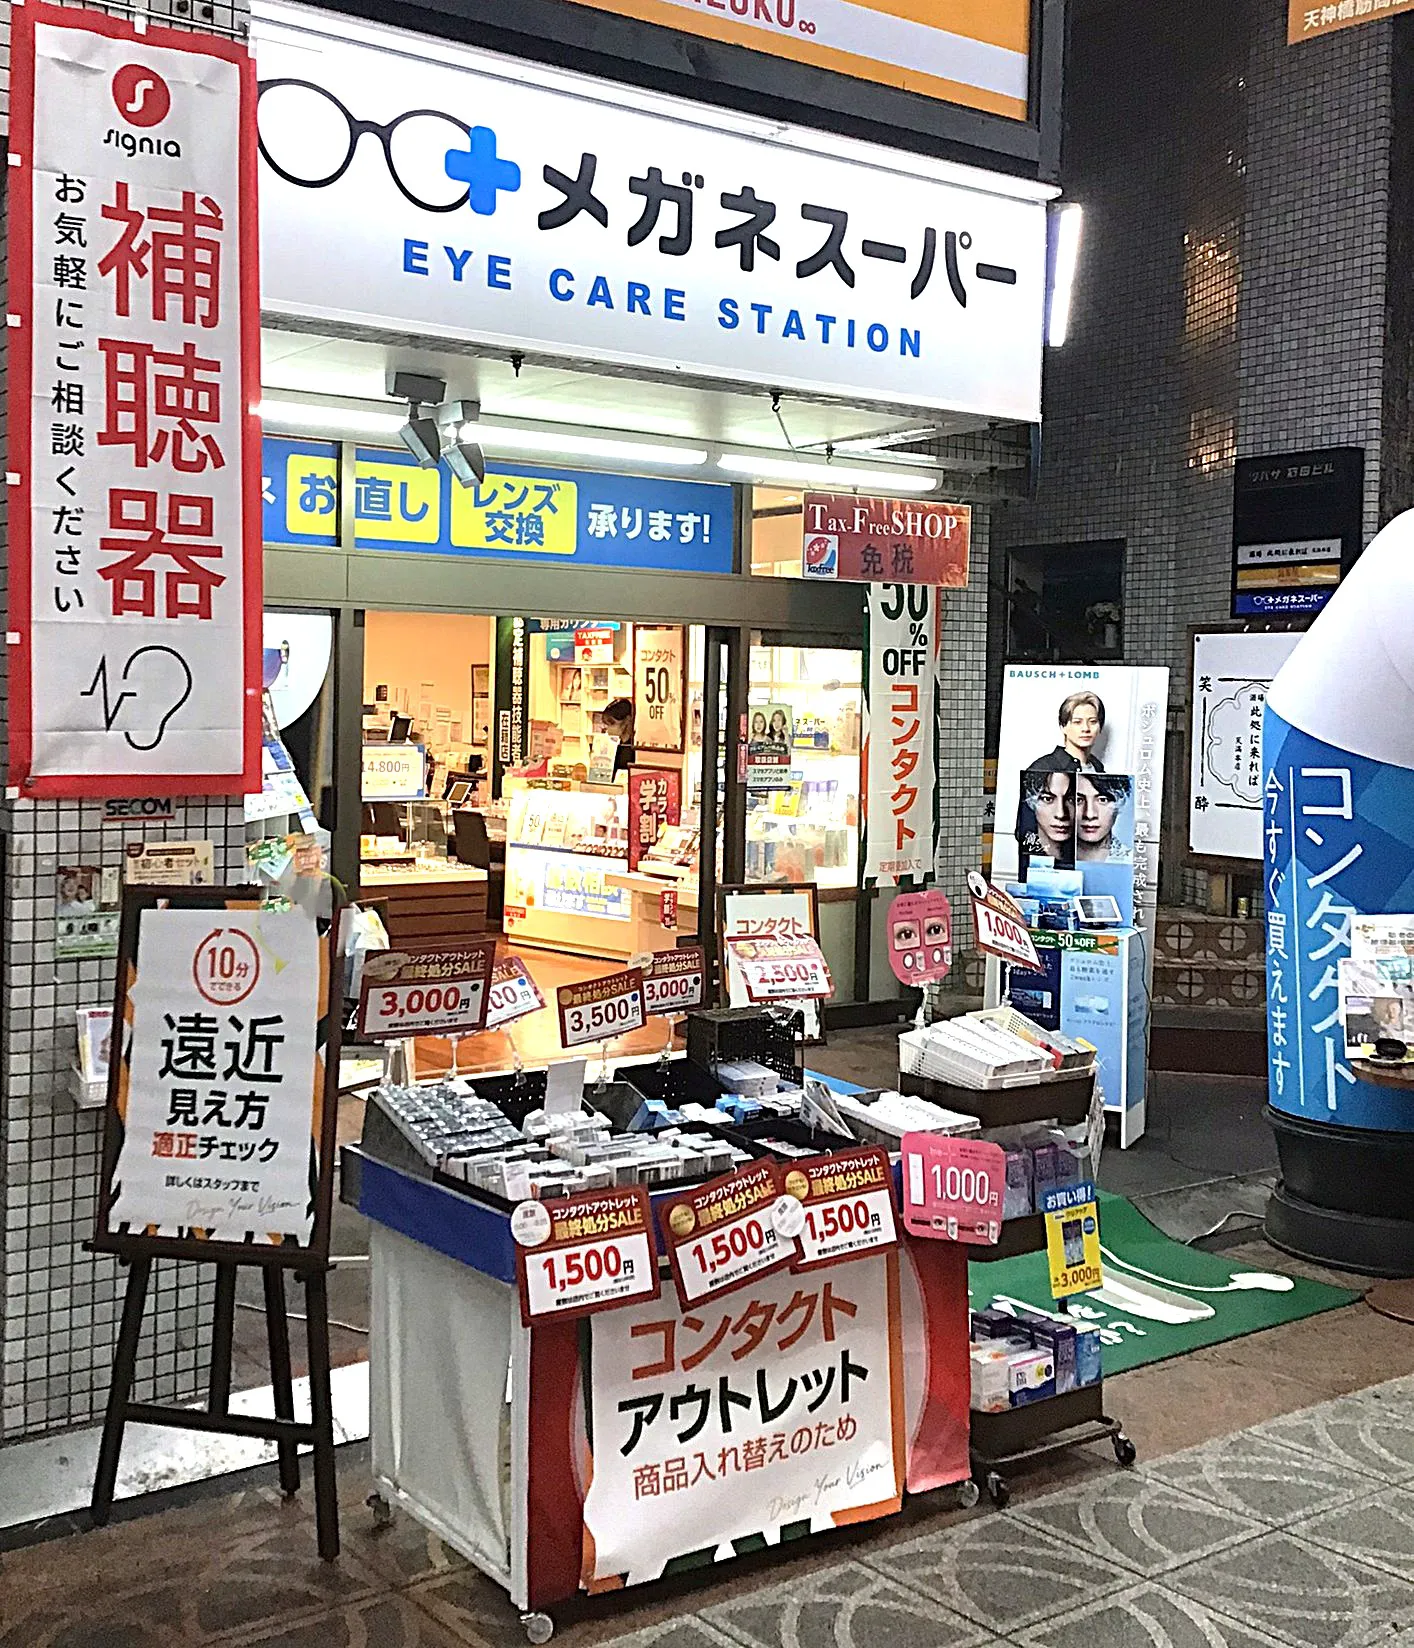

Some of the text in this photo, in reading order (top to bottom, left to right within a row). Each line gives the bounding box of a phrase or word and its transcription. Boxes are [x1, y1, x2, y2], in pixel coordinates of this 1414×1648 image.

[103, 129, 181, 158] signia
[538, 153, 1017, 308] メガネスーパー
[402, 239, 921, 358] EYE CARE STATION
[51, 173, 87, 613] お気軽にご相談ください
[96, 181, 226, 621] 補聴器
[299, 472, 430, 522] お直し
[474, 482, 561, 514] レンズ
[485, 511, 545, 546] 交換
[640, 649, 677, 664] コンタクト
[882, 648, 927, 677] OFF
[1198, 676, 1213, 693] 笑
[649, 705, 665, 720] OFF
[890, 683, 921, 851] コンタクト
[105, 799, 172, 816] SECOM
[736, 917, 803, 935] コンタクト
[1264, 767, 1291, 1096] 今すぐ買えます
[159, 1012, 285, 1084] 遠近
[166, 1088, 269, 1131] 見え方
[151, 1131, 280, 1163] 適正チェック
[165, 1175, 260, 1192] 詳しくはスタッフまで
[630, 1282, 858, 1381] コンタクト
[617, 1349, 869, 1458] アウトレット
[632, 1413, 858, 1501] 商品入れ替えのため
